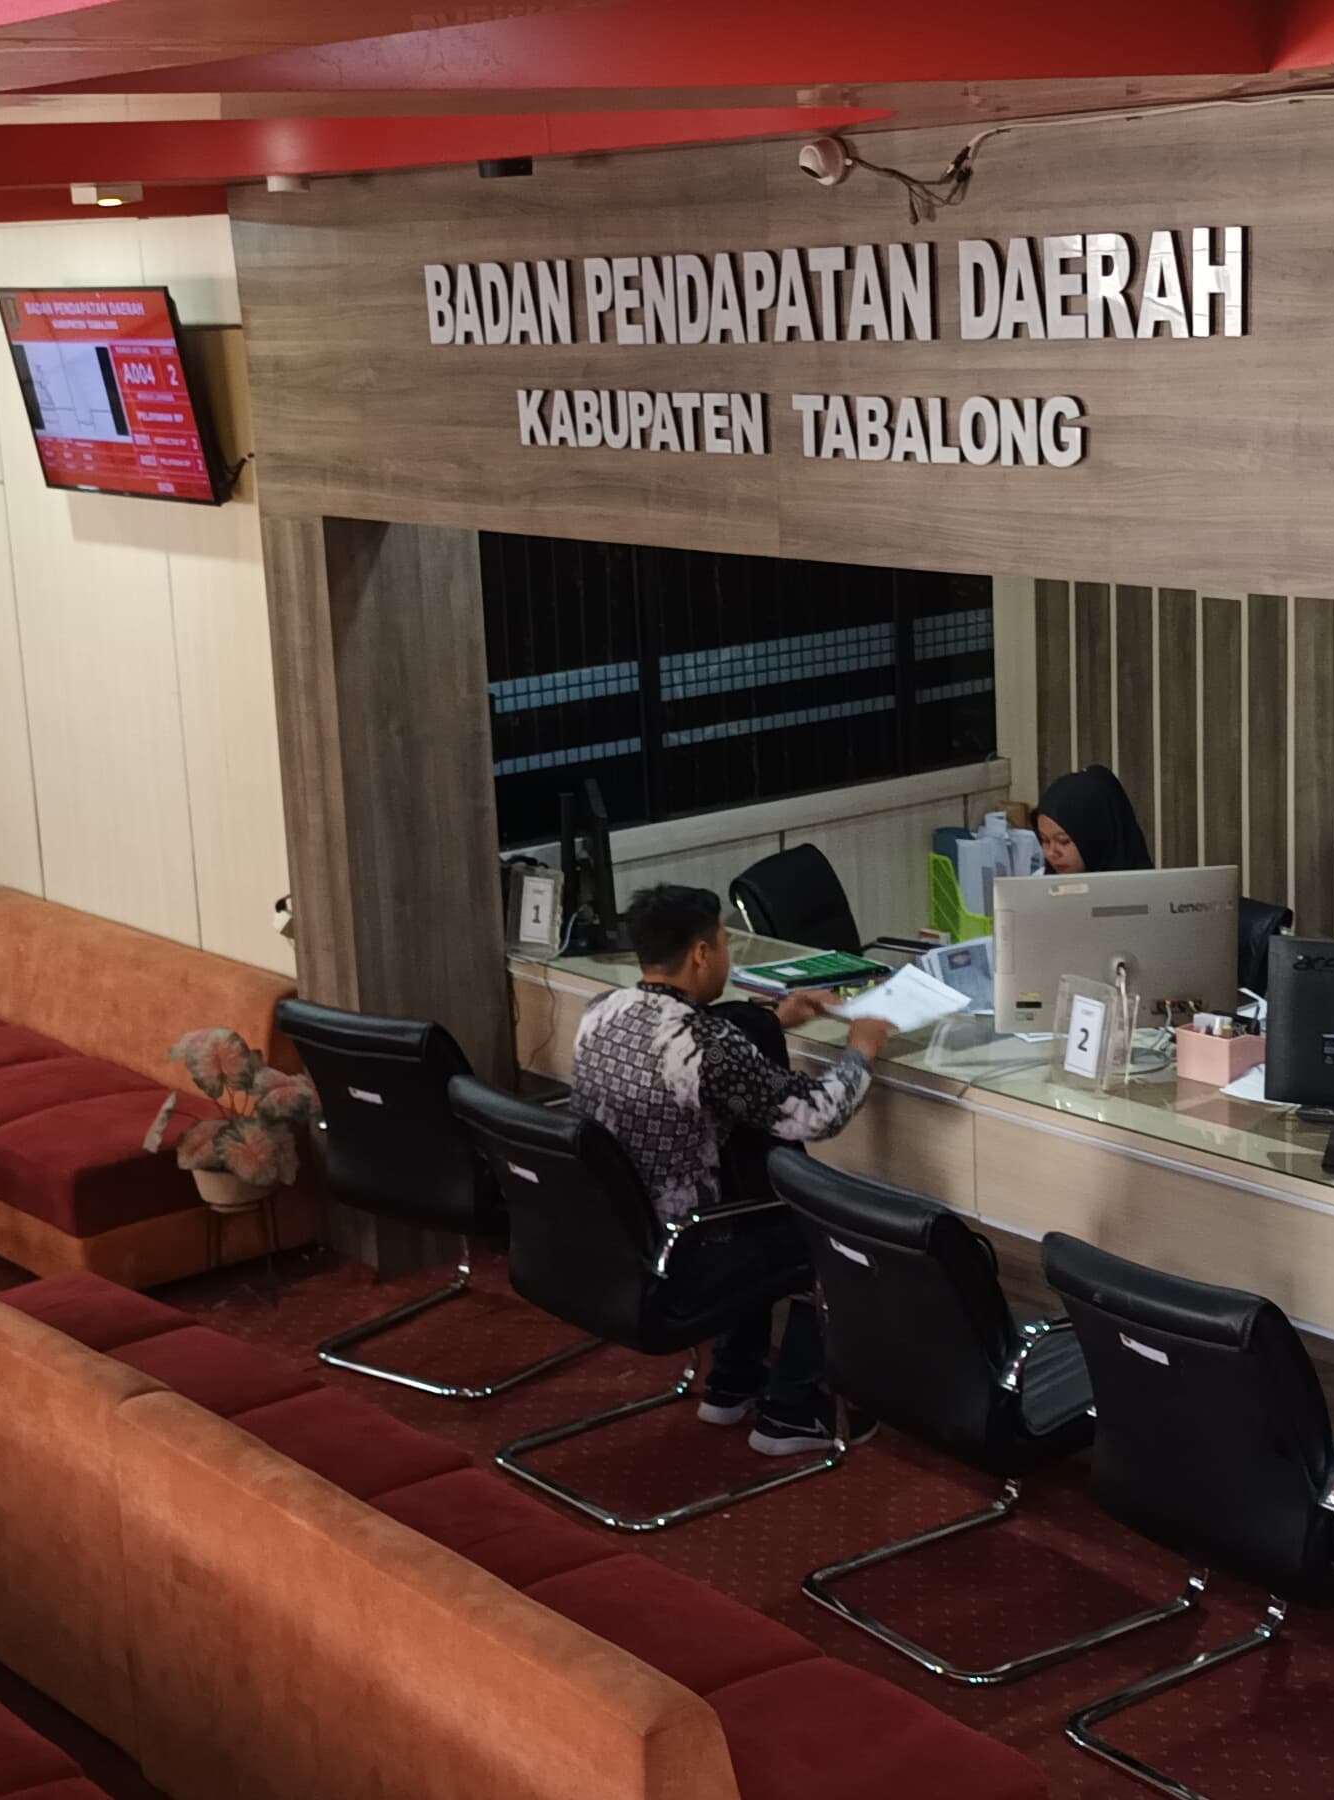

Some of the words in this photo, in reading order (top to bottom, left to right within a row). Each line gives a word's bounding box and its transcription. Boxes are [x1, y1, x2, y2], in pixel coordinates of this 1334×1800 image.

[424, 258, 575, 346] BADAN
[584, 241, 935, 346] PENDAPATAN
[957, 226, 1251, 341] DAERAH
[166, 364, 180, 387] 2
[516, 389, 770, 456] KABUPATEN
[791, 393, 1088, 469] TABALONG
[532, 904, 542, 925] 1
[1077, 1027, 1090, 1053] 2
